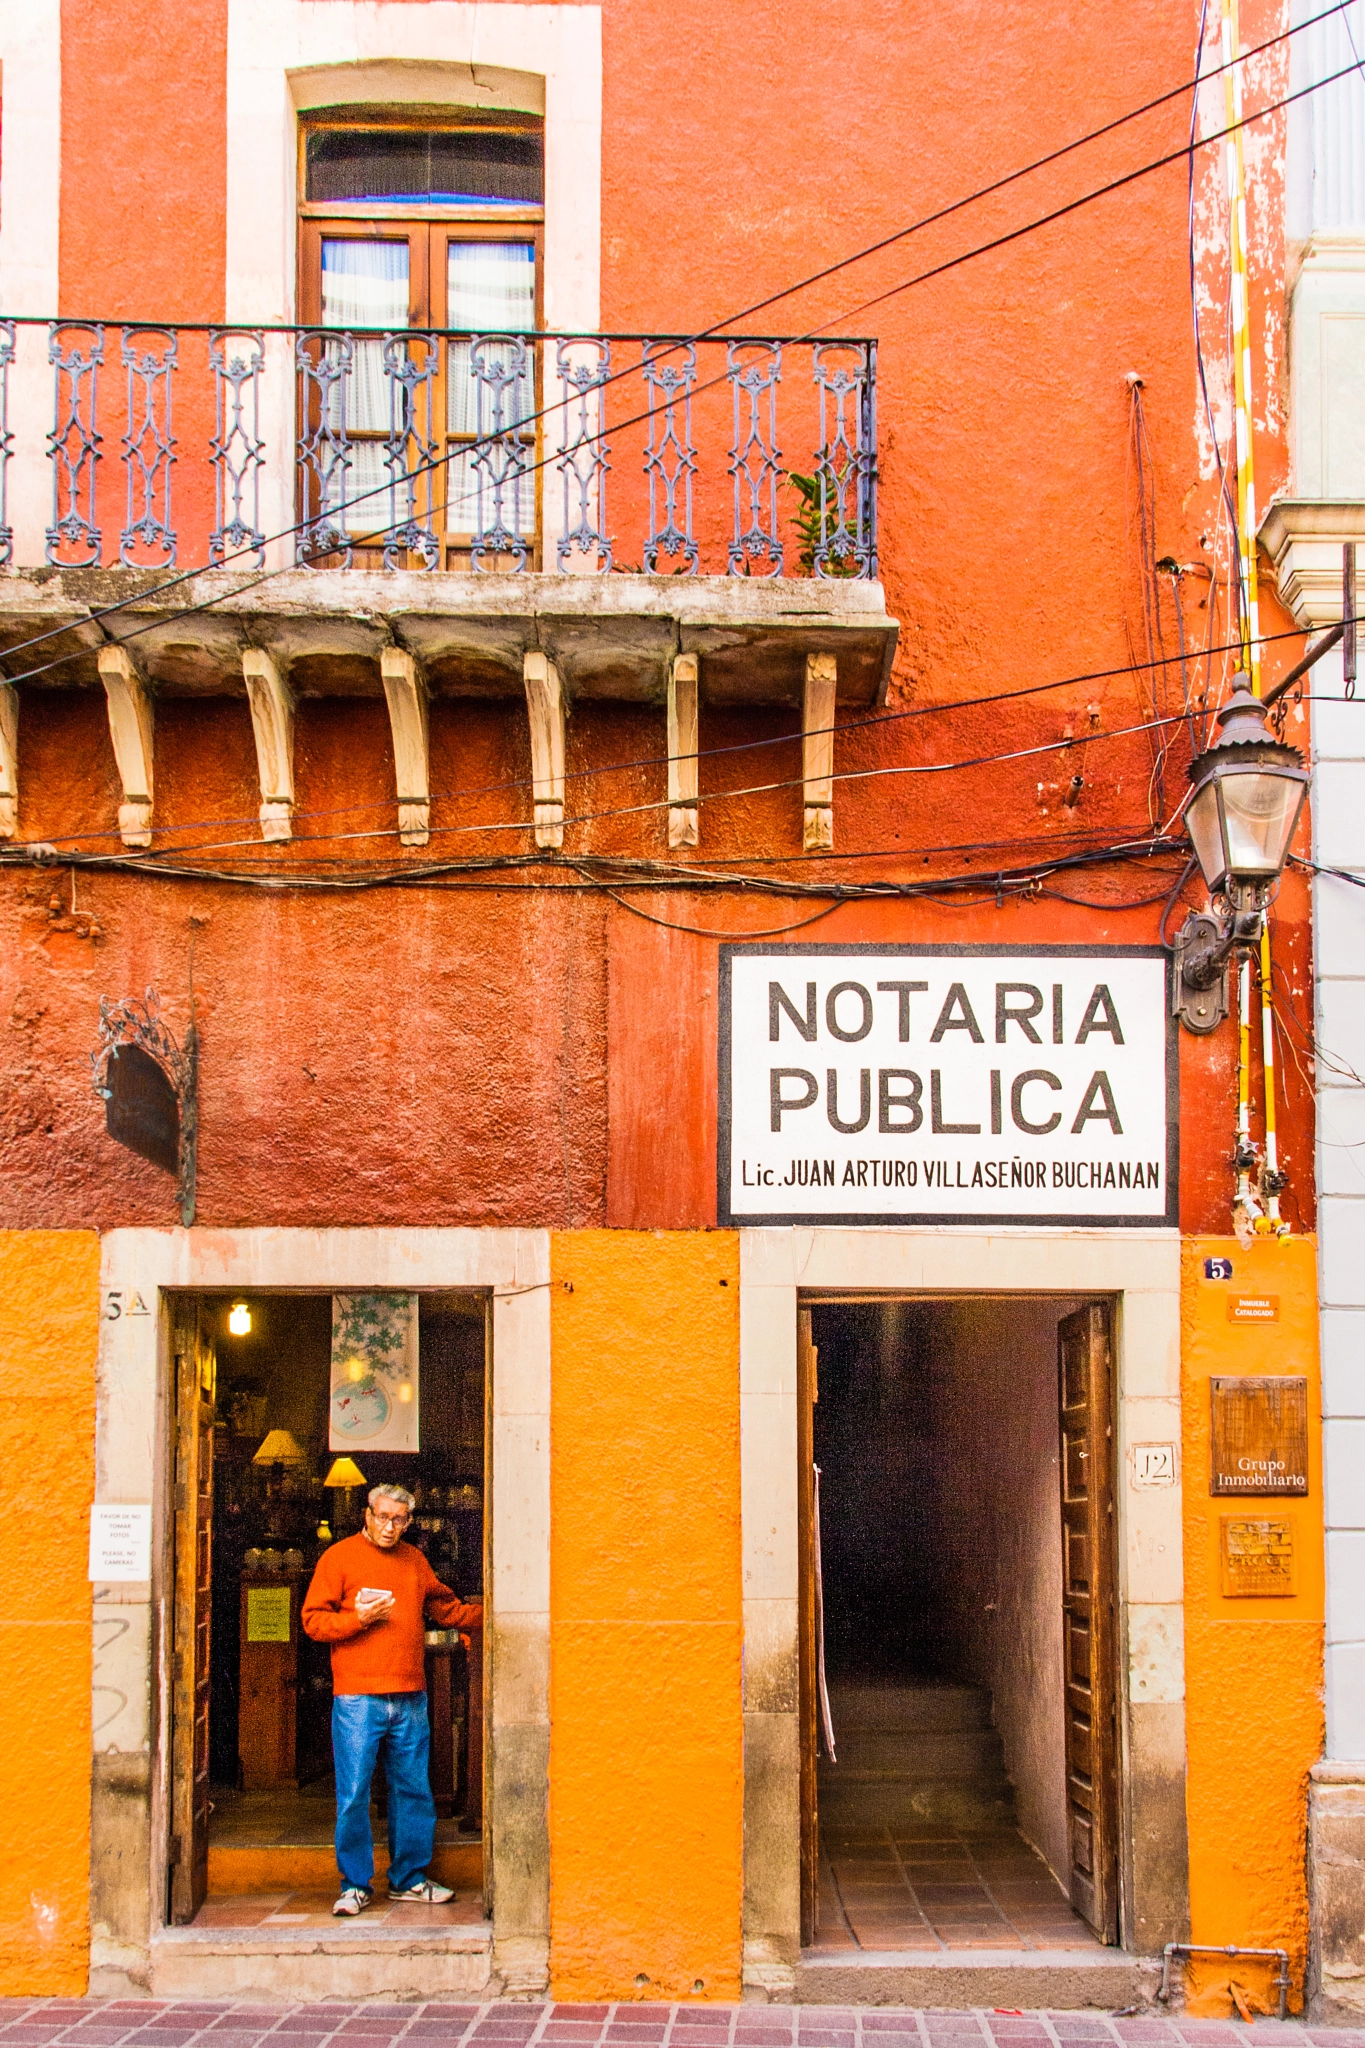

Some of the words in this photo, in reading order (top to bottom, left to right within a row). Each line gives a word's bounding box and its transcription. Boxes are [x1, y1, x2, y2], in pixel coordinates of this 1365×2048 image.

[769, 982, 1124, 1044] NOTARIA
[771, 1069, 1123, 1134] PUBLICA
[842, 1160, 917, 1186] ARTURO
[924, 1156, 1046, 1188] VILLASEÑOR
[1053, 1162, 1158, 1188] BUCHANAN
[1211, 1257, 1225, 1279] 5
[1218, 1473, 1305, 1486] Inmobiliario
[1238, 1457, 1285, 1475] Grupo
